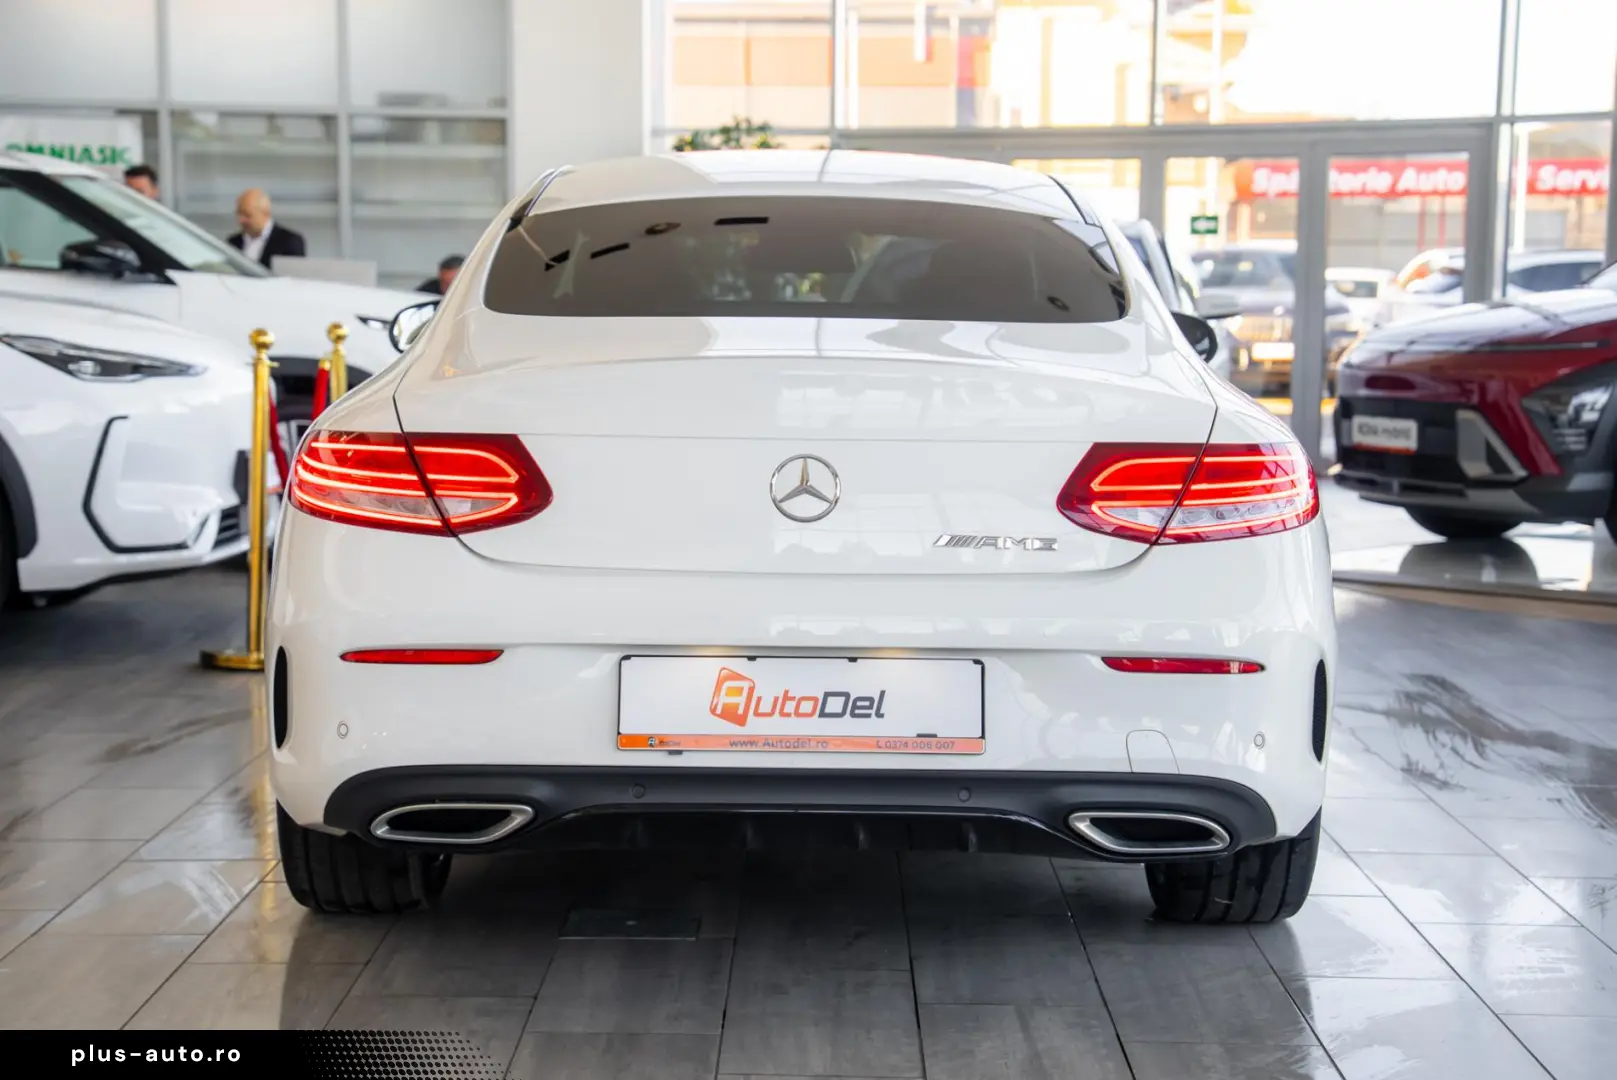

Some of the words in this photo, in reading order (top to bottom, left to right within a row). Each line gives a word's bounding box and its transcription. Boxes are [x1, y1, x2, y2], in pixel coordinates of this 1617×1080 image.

[1396, 166, 1465, 193] Auto
[713, 678, 887, 720] AutoDel
[729, 737, 829, 749] www.Autodel.ro
[936, 741, 956, 750] 007
